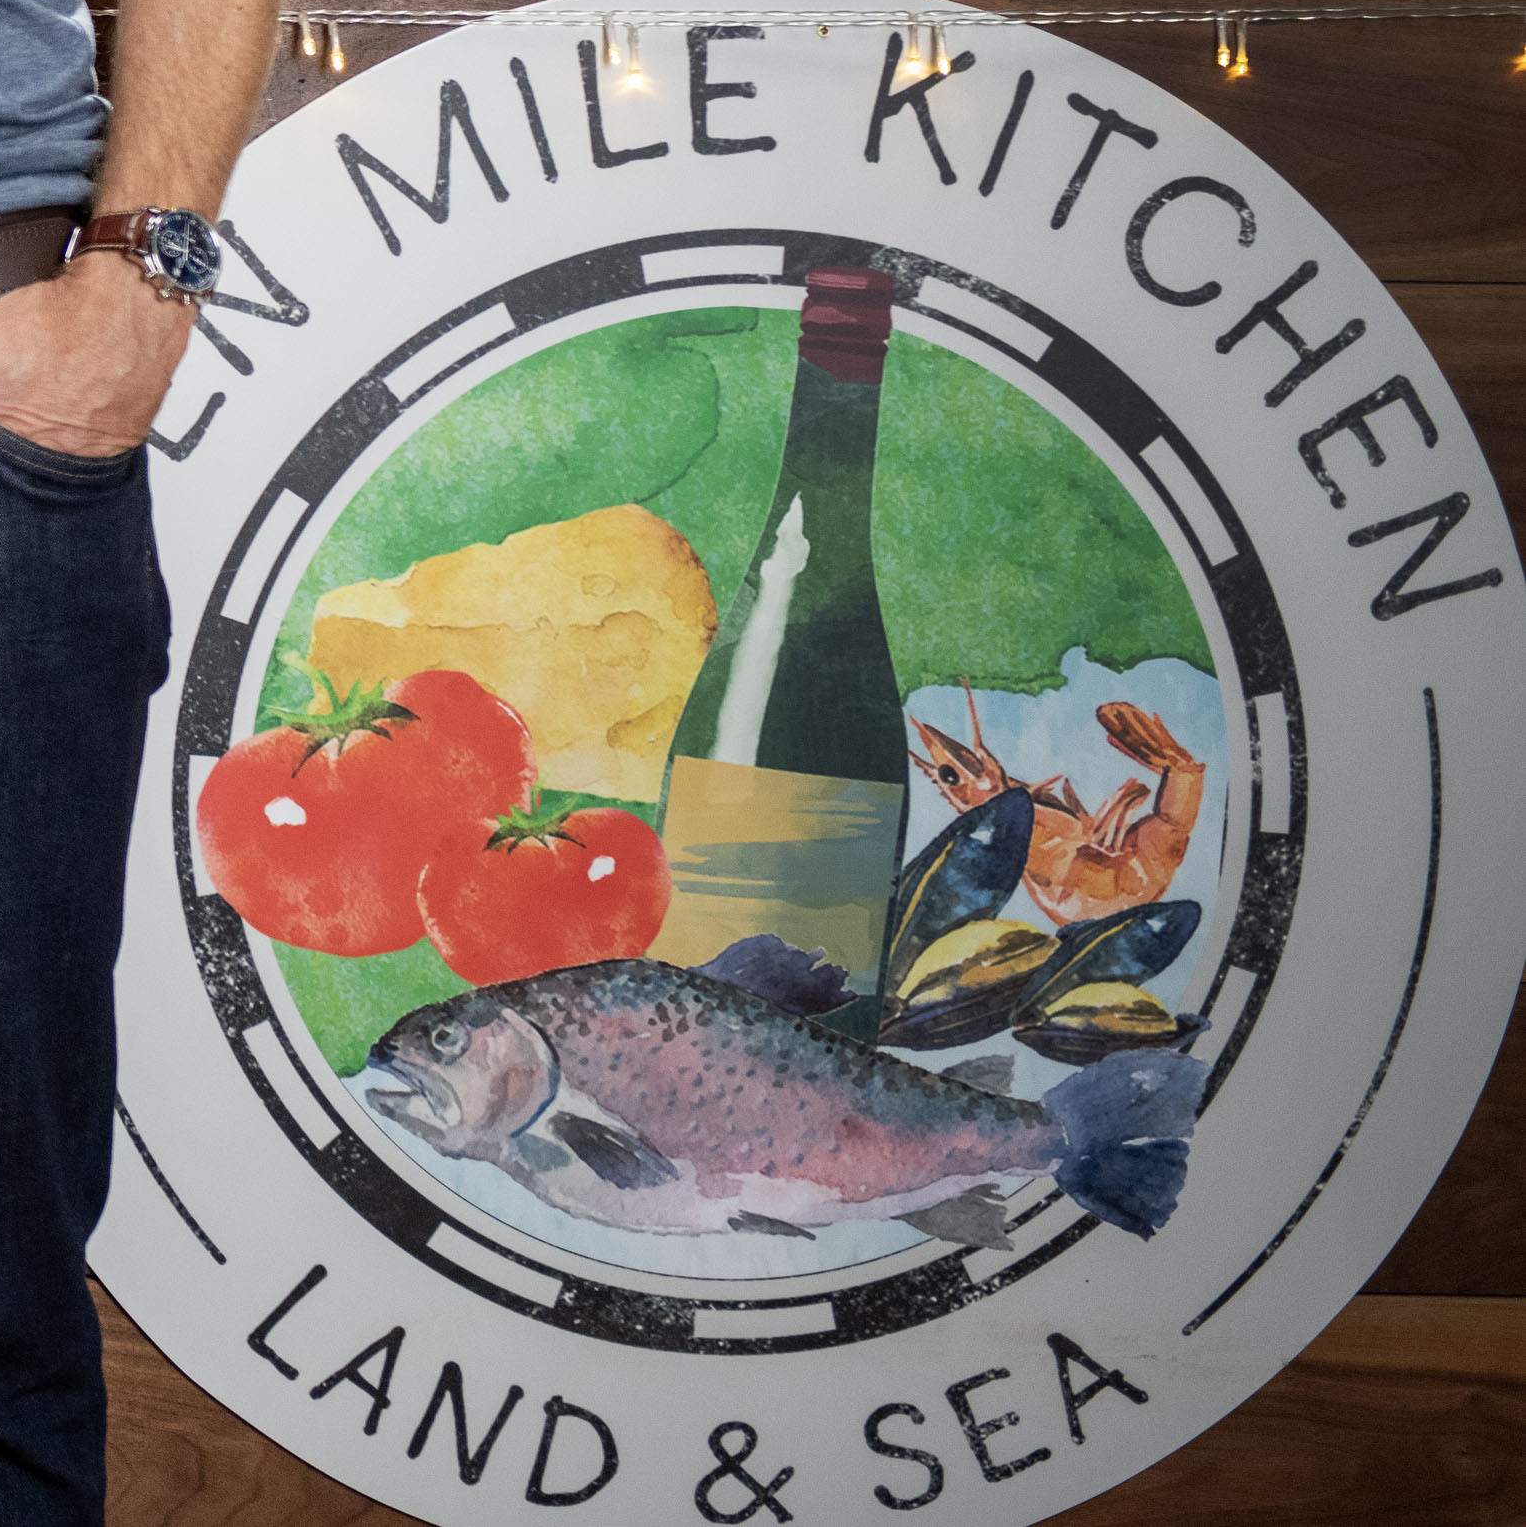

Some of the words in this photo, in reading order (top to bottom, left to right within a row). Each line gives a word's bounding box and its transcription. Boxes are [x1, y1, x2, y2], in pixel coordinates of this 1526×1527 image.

[336, 25, 777, 256] MILE
[864, 31, 1504, 622] KITCHEN
[246, 1263, 621, 1508] LAND
[693, 1420, 795, 1526] &
[862, 1331, 1151, 1512] SEA
